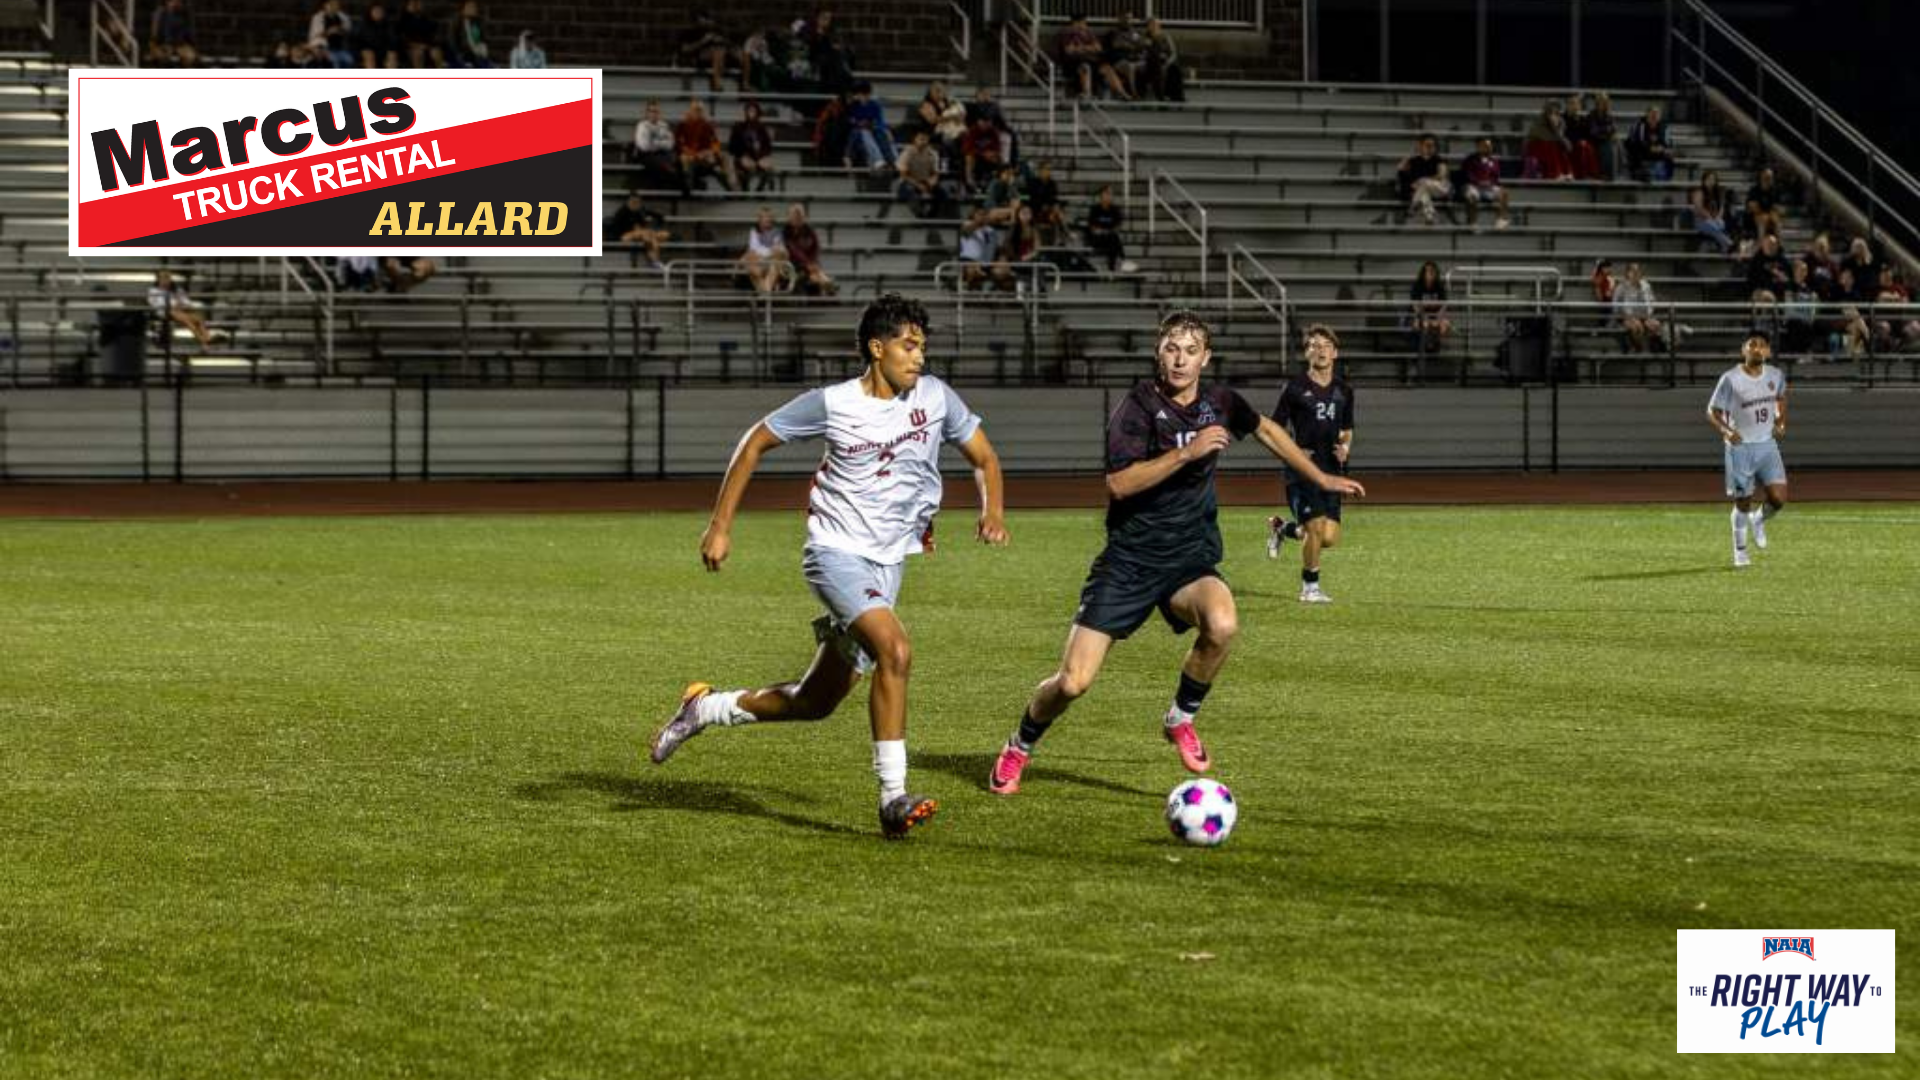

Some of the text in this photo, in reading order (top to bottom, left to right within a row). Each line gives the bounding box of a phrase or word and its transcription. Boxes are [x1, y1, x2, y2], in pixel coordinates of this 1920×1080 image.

[1315, 402, 1336, 420] 24
[1754, 408, 1769, 424] 19
[877, 449, 895, 477] 2
